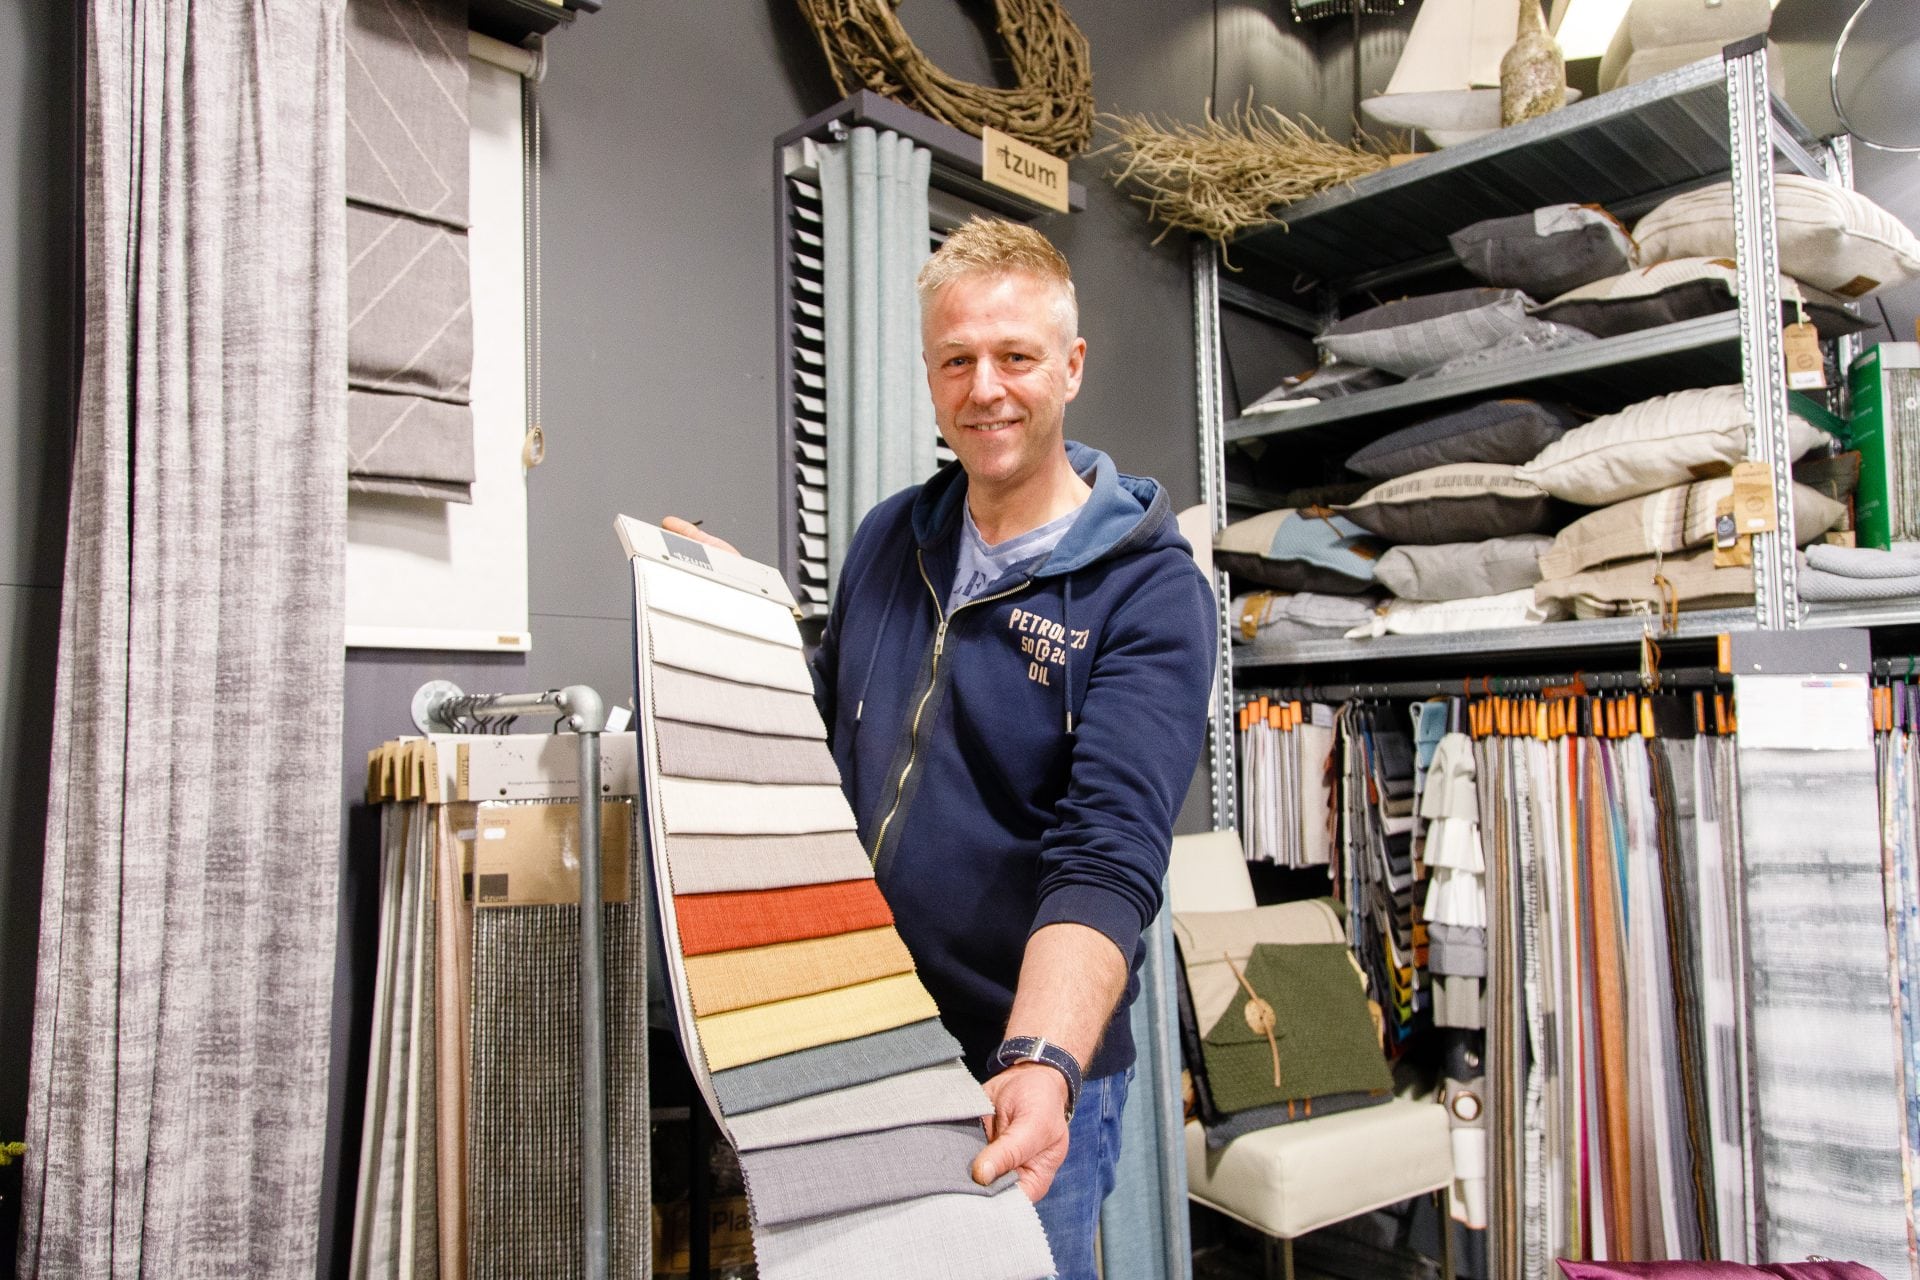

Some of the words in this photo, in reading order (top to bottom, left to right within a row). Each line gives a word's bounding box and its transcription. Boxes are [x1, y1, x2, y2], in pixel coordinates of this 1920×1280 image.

[997, 145, 1057, 189] tzum
[674, 552, 713, 571] tzum
[1008, 608, 1065, 644] PETROL
[1021, 636, 1035, 654] 50
[1028, 661, 1050, 686] OIL
